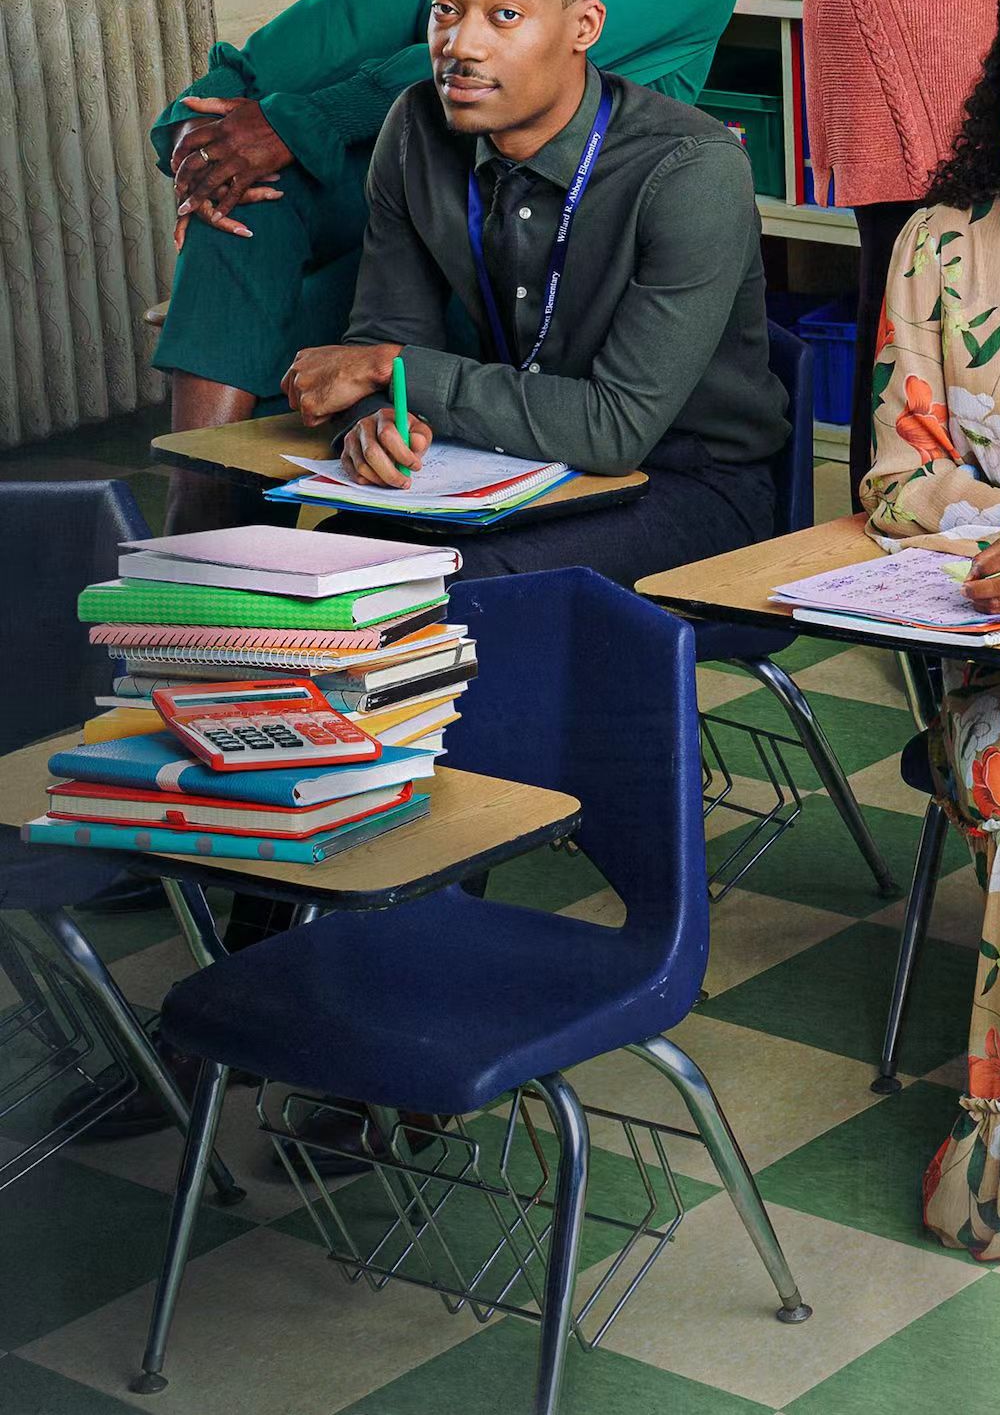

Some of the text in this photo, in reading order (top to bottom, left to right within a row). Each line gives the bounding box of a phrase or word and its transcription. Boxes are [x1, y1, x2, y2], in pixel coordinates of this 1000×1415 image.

[557, 131, 601, 242] Willard R. Abbott Elementary
[539, 315, 551, 339] Abbott
[545, 271, 560, 314] Elementary
